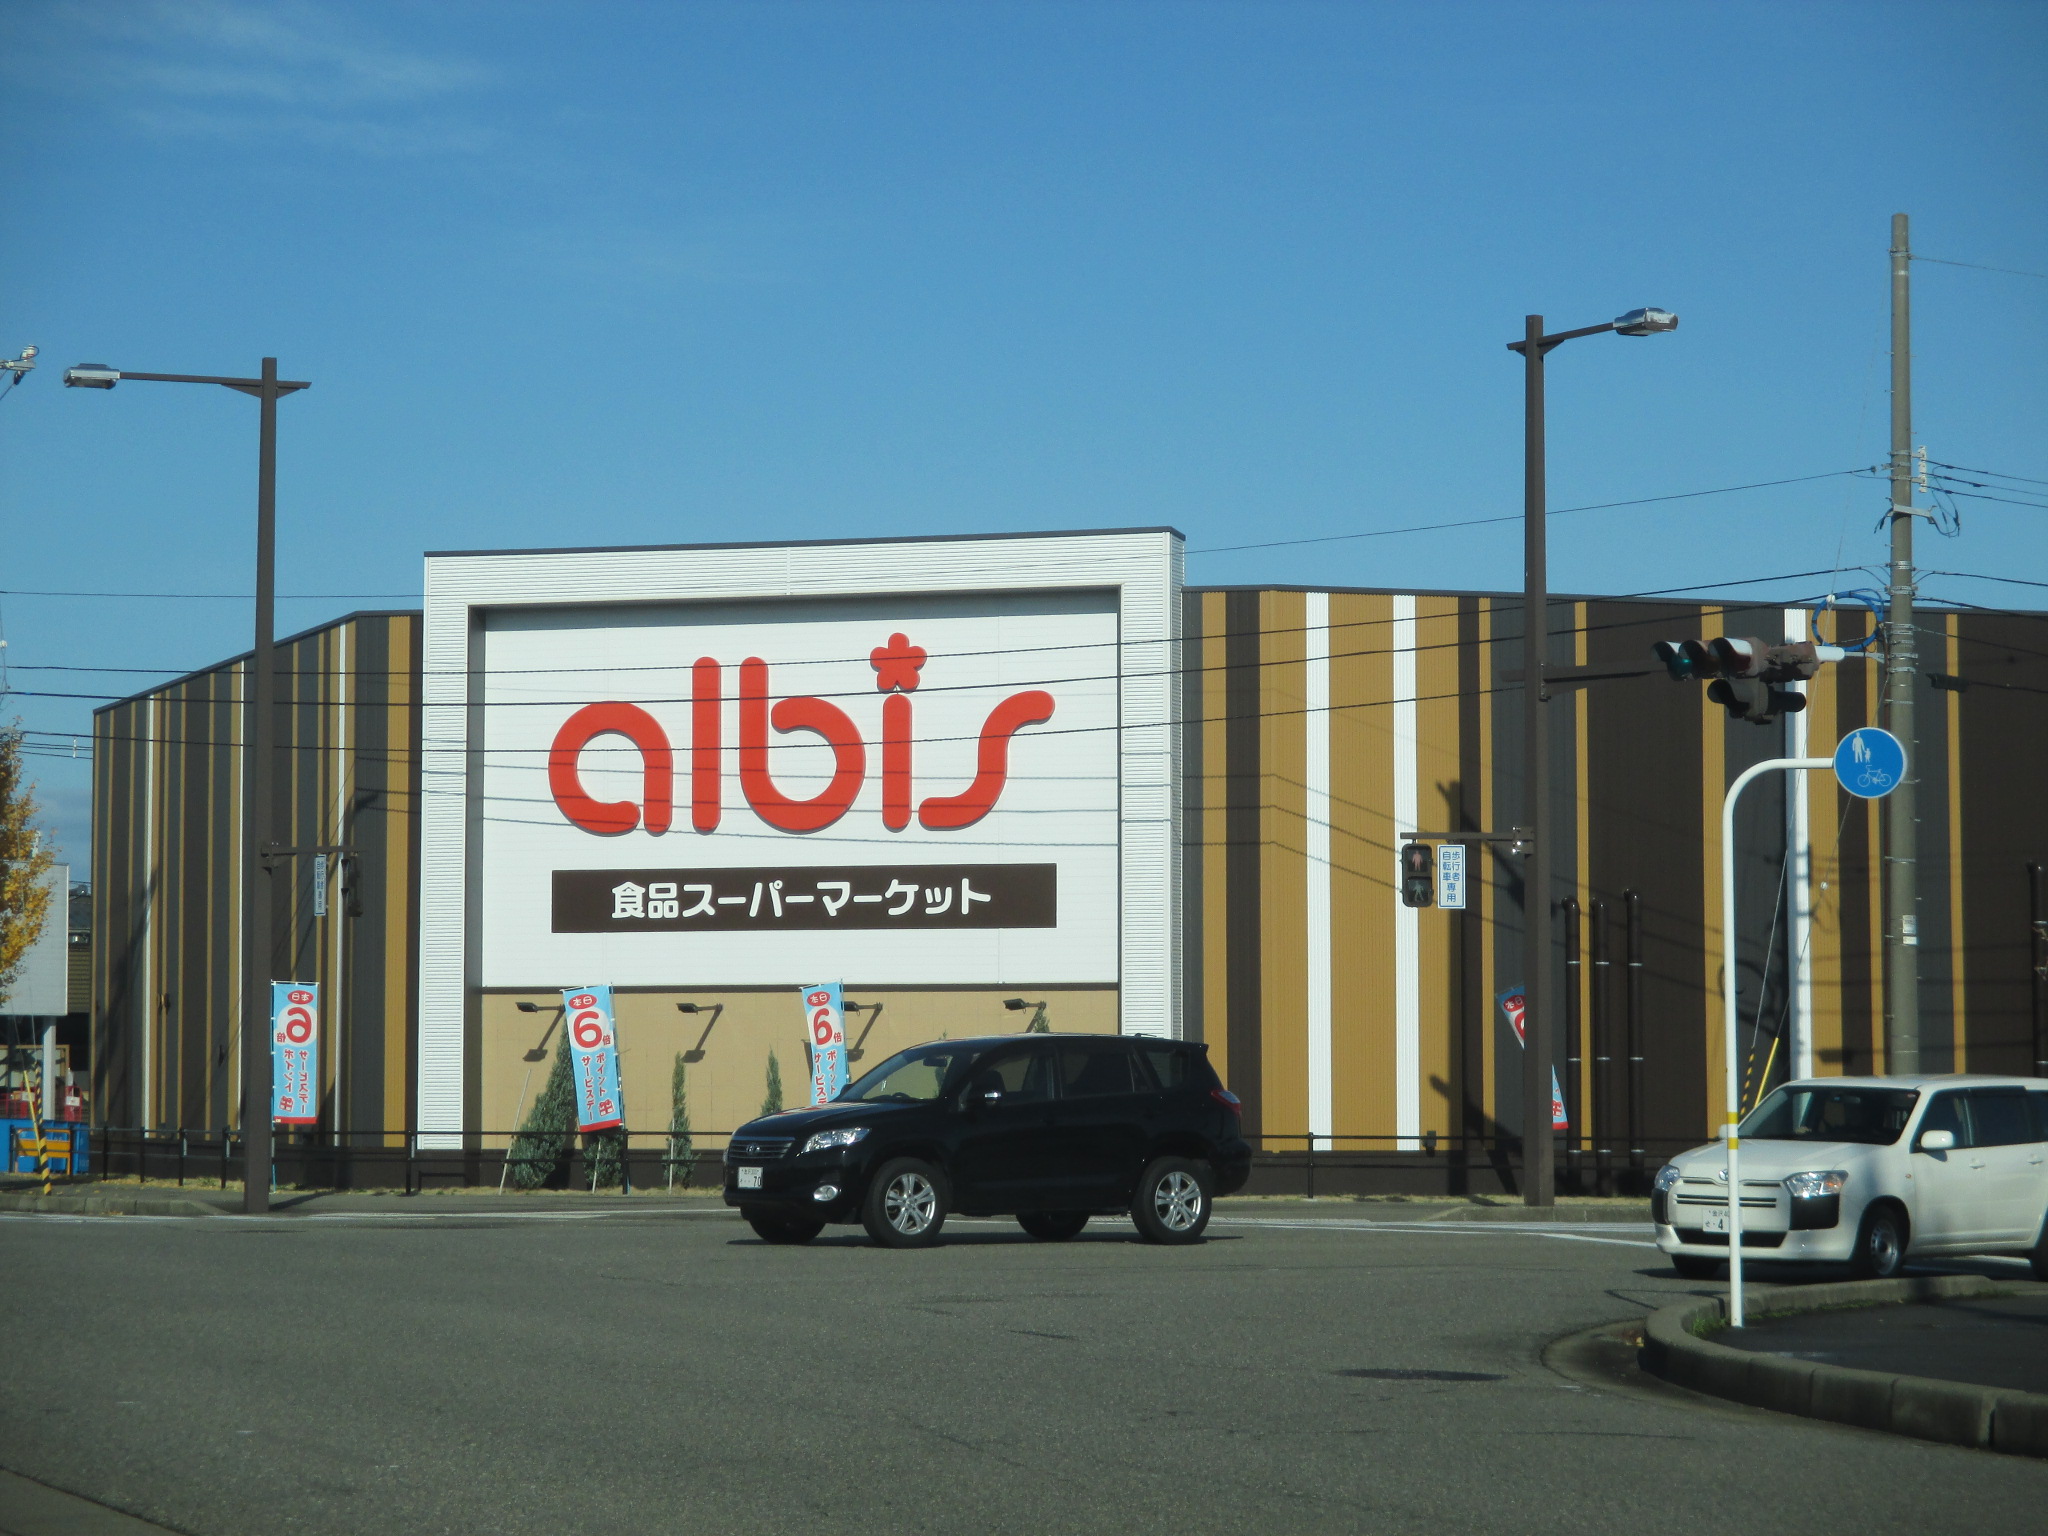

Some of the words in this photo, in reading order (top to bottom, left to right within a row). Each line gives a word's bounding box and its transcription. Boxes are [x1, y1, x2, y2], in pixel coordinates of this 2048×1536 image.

[548, 632, 1056, 836] albis
[611, 878, 991, 919] 食品スーパーマーケット
[572, 996, 593, 1007] 本日
[809, 993, 828, 1003] 本日
